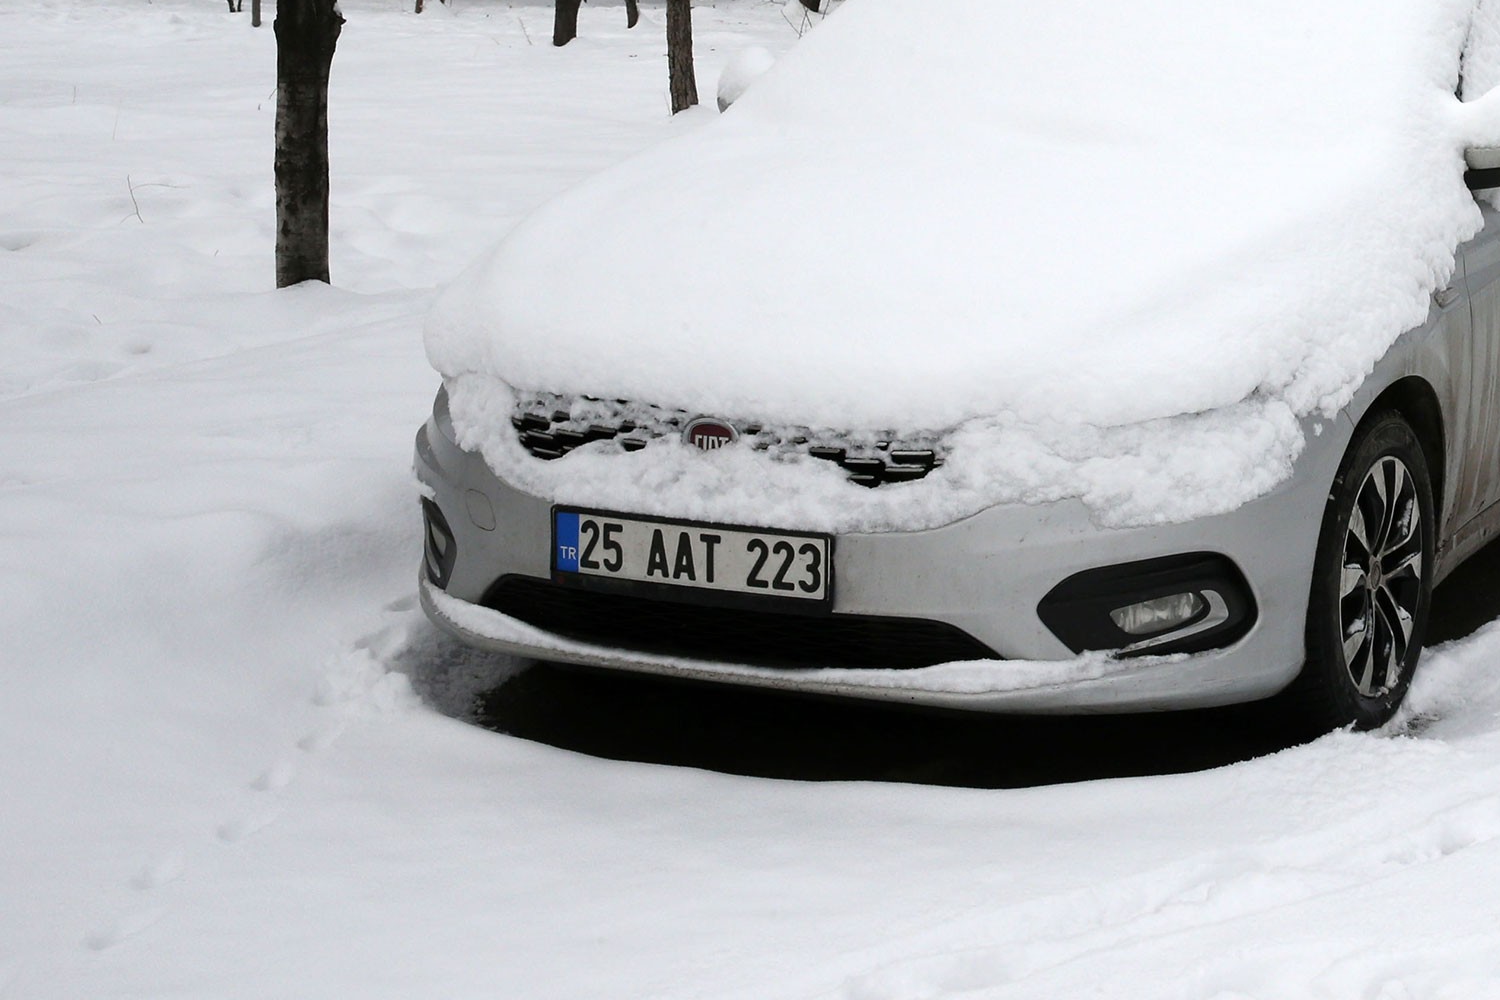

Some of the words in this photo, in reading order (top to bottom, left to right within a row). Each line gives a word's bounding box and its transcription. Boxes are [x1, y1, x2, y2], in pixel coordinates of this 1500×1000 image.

[560, 545, 577, 561] TR
[579, 519, 624, 573] 25
[646, 528, 722, 584] AAT
[746, 538, 821, 594] 223
